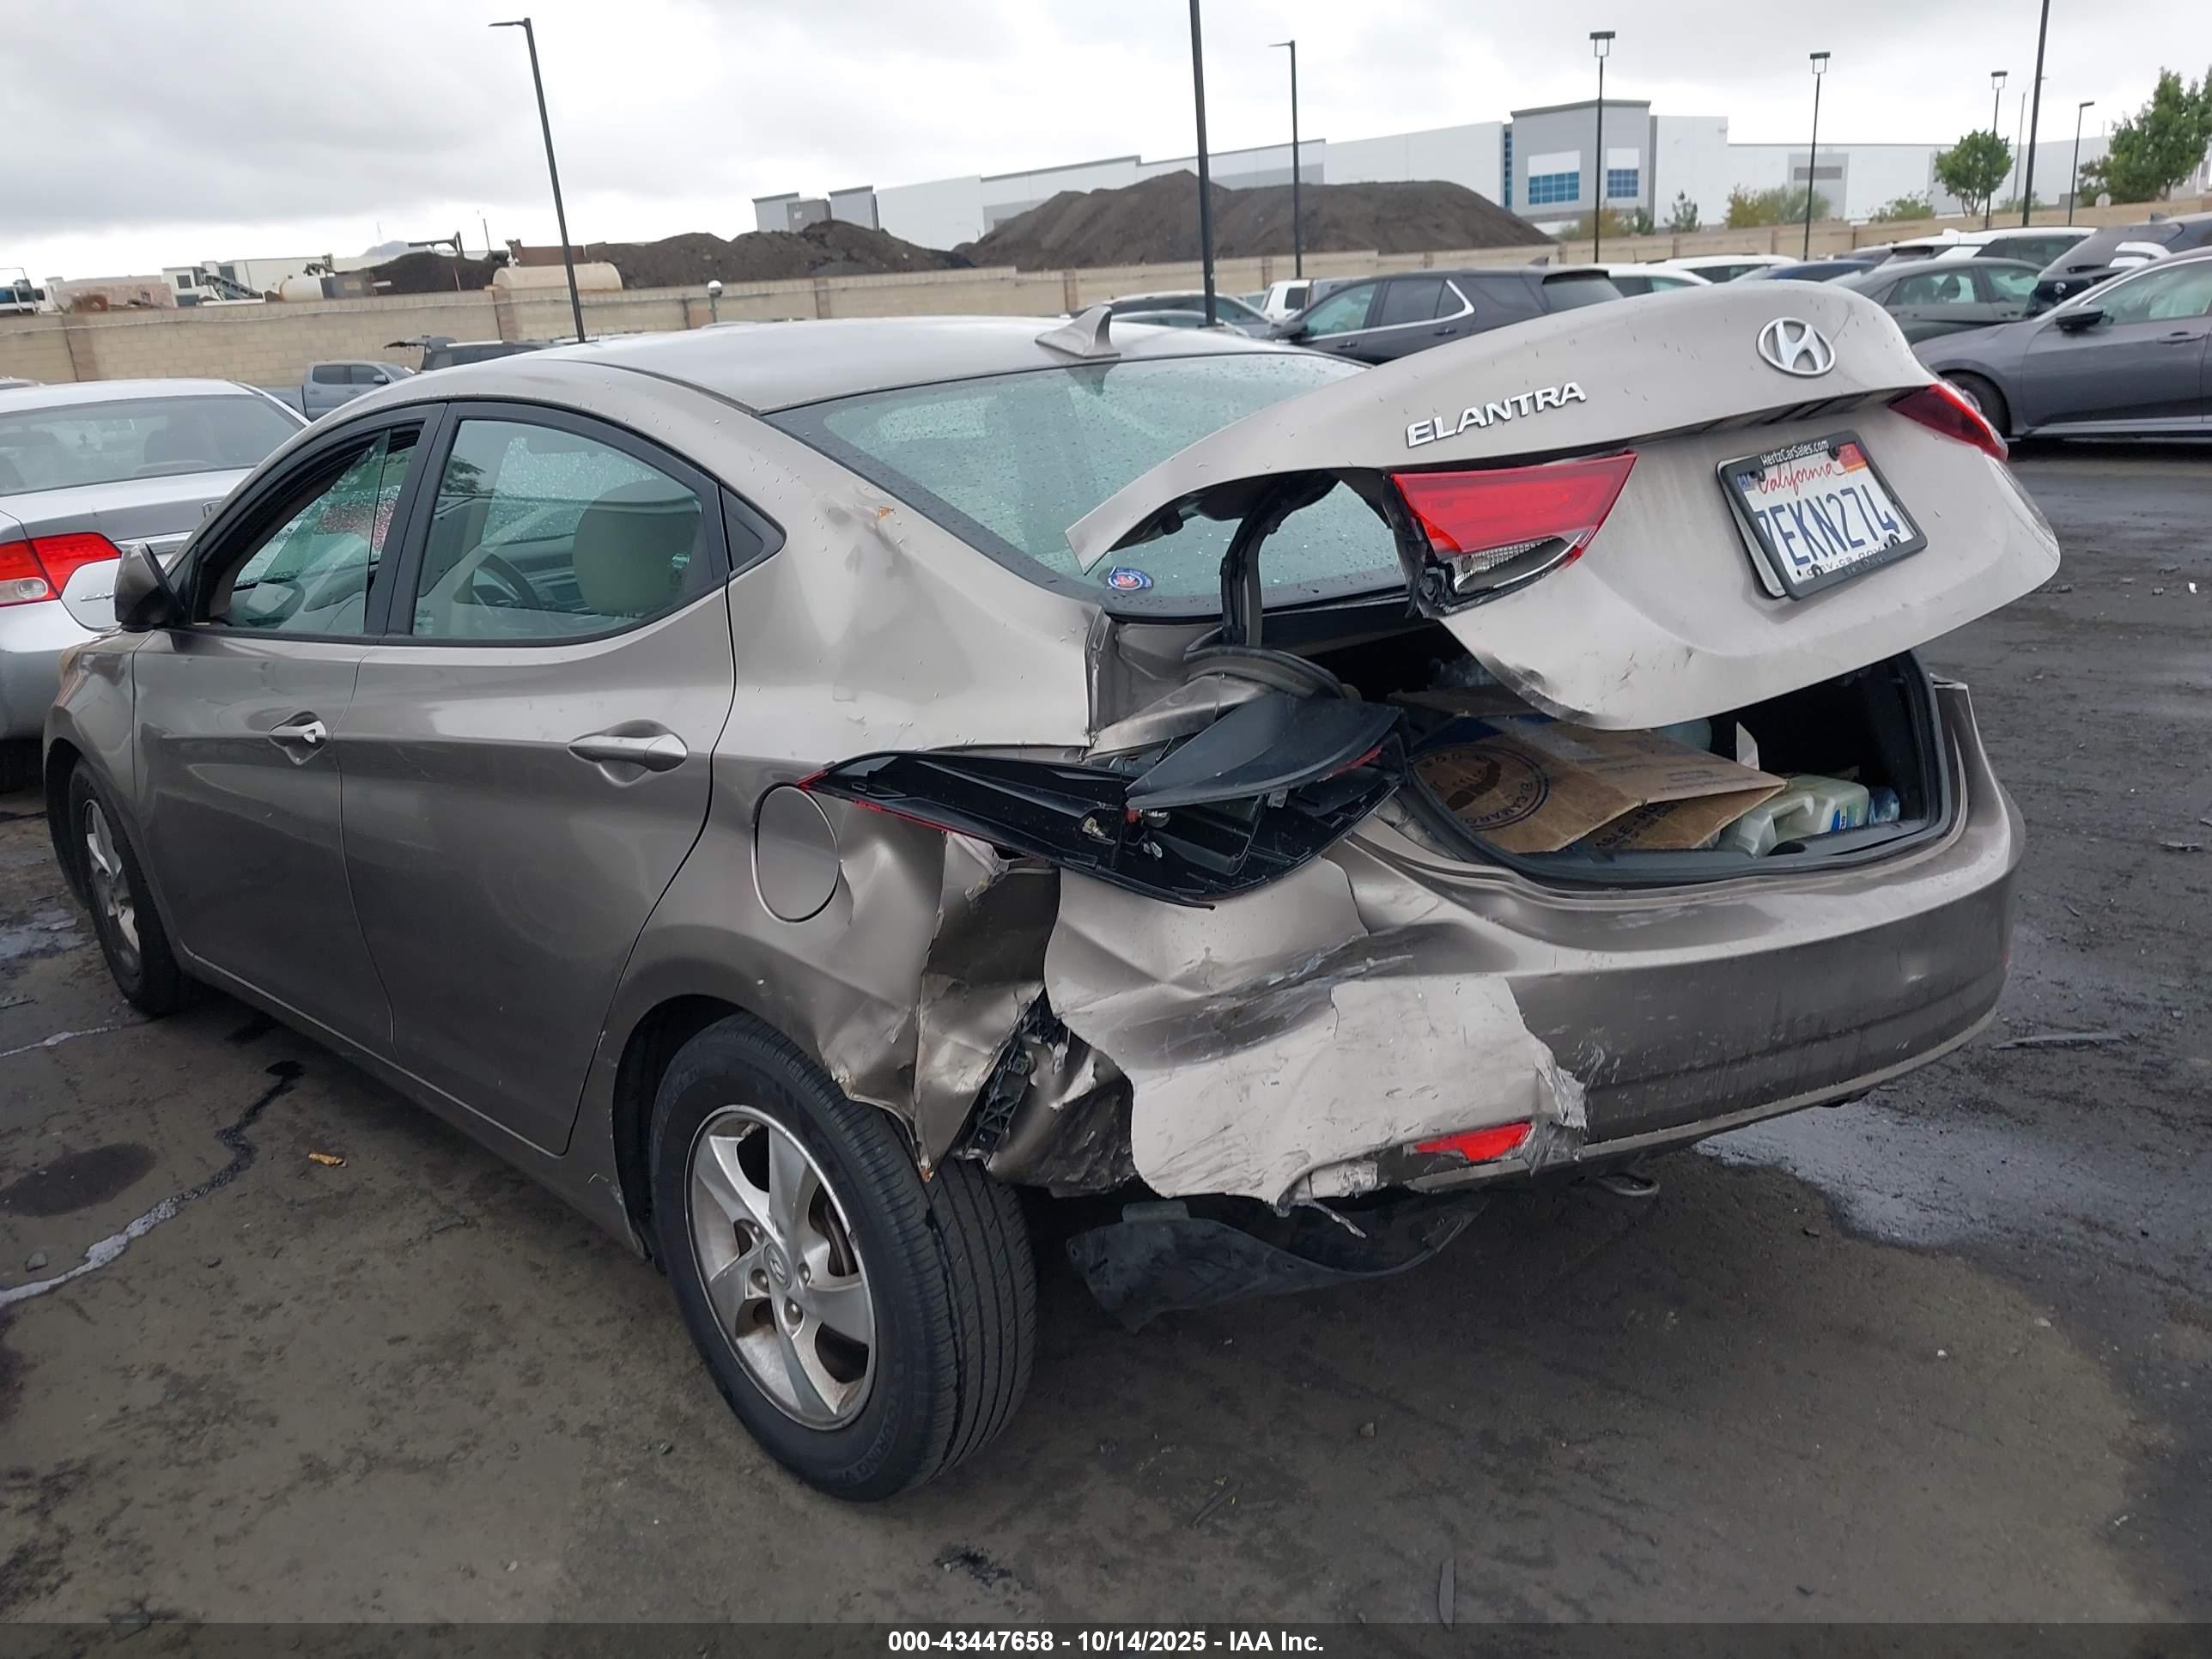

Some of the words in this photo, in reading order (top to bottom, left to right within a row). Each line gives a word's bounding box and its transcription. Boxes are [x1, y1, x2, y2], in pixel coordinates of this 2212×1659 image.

[1407, 381, 1587, 448] ELANTRA
[1760, 440, 1829, 467] HertzCarSales.com
[1759, 459, 1844, 495] California
